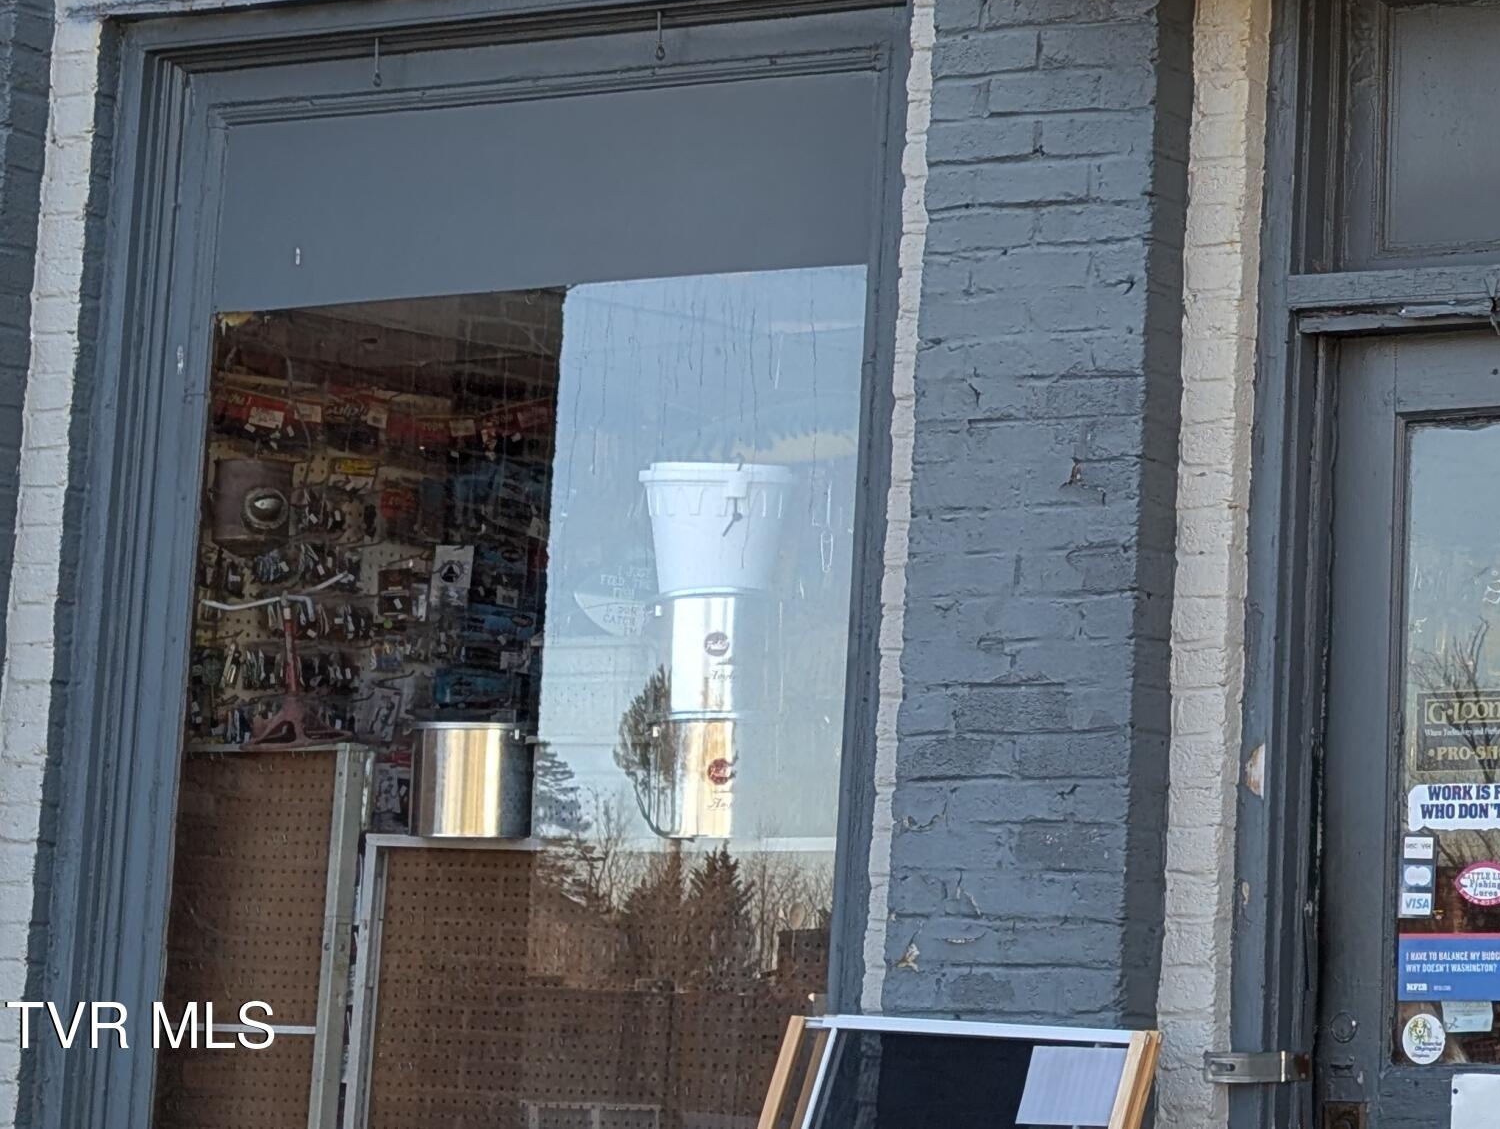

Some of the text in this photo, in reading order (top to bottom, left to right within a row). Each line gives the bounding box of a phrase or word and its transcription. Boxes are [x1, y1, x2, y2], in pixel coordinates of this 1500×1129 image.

[1428, 785, 1473, 801] WORK
[1476, 785, 1490, 800] IS
[1420, 804, 1455, 819] WHO
[1405, 898, 1429, 909] VISA
[1410, 951, 1427, 961] HAVE
[1428, 951, 1437, 961] TO
[1439, 951, 1468, 961] BALANCE
[1470, 951, 1480, 961] MY
[1406, 963, 1421, 973] WHY
